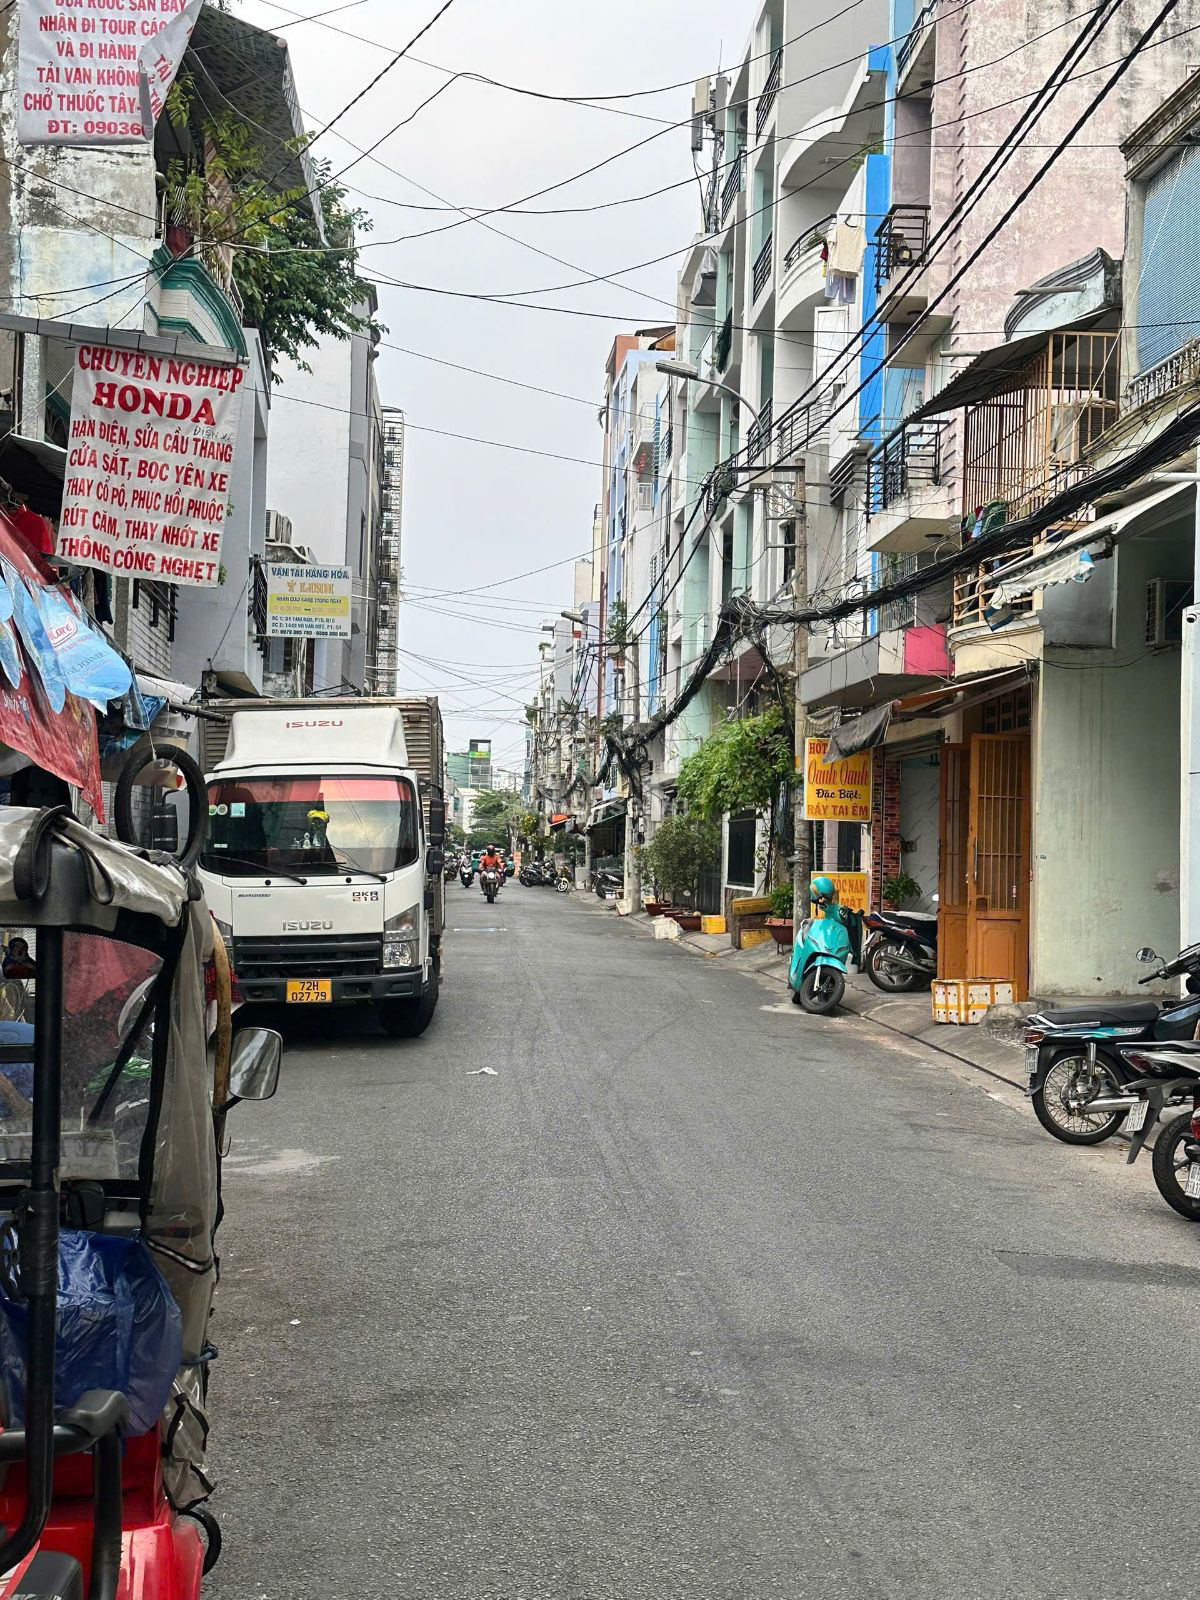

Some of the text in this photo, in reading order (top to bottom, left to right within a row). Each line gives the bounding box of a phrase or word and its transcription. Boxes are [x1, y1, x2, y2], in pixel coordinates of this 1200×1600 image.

[39, 12, 77, 34] NHẬN
[81, 17, 96, 33] ĐI
[100, 19, 136, 35] TOUR
[56, 37, 136, 60] VÀ ĐI HÀNH
[37, 61, 60, 83] TẢI
[64, 67, 92, 84] VAN
[24, 87, 53, 111] CHỞ
[57, 89, 105, 112] THUỐC
[48, 120, 145, 136] ĐT: 09036
[79, 345, 243, 397] CHUYÊN NGHIỆP
[92, 382, 216, 426] HONDA
[72, 415, 232, 463] HÀN ĐIỆN, SỬA CẦU THANG
[69, 441, 228, 492] CỬA SẮT, BỌC YÊN XE
[67, 475, 223, 524] THAY CỔ PÔ, PHỤC HỒI PHUỘC
[63, 502, 220, 551] RÚT CĂM, THAY NHỚT XE
[61, 535, 216, 582] THÔNG CỐNG NGHẸT
[306, 568, 329, 578] HÀNG
[286, 720, 343, 728] ISUZU
[840, 760, 868, 785] Oanh
[808, 803, 868, 816] RÁY TAI ÊM
[848, 879, 865, 893] NAM
[282, 921, 333, 931] ISUZU
[291, 991, 327, 1001] 027.79
[299, 981, 319, 991] 72H
